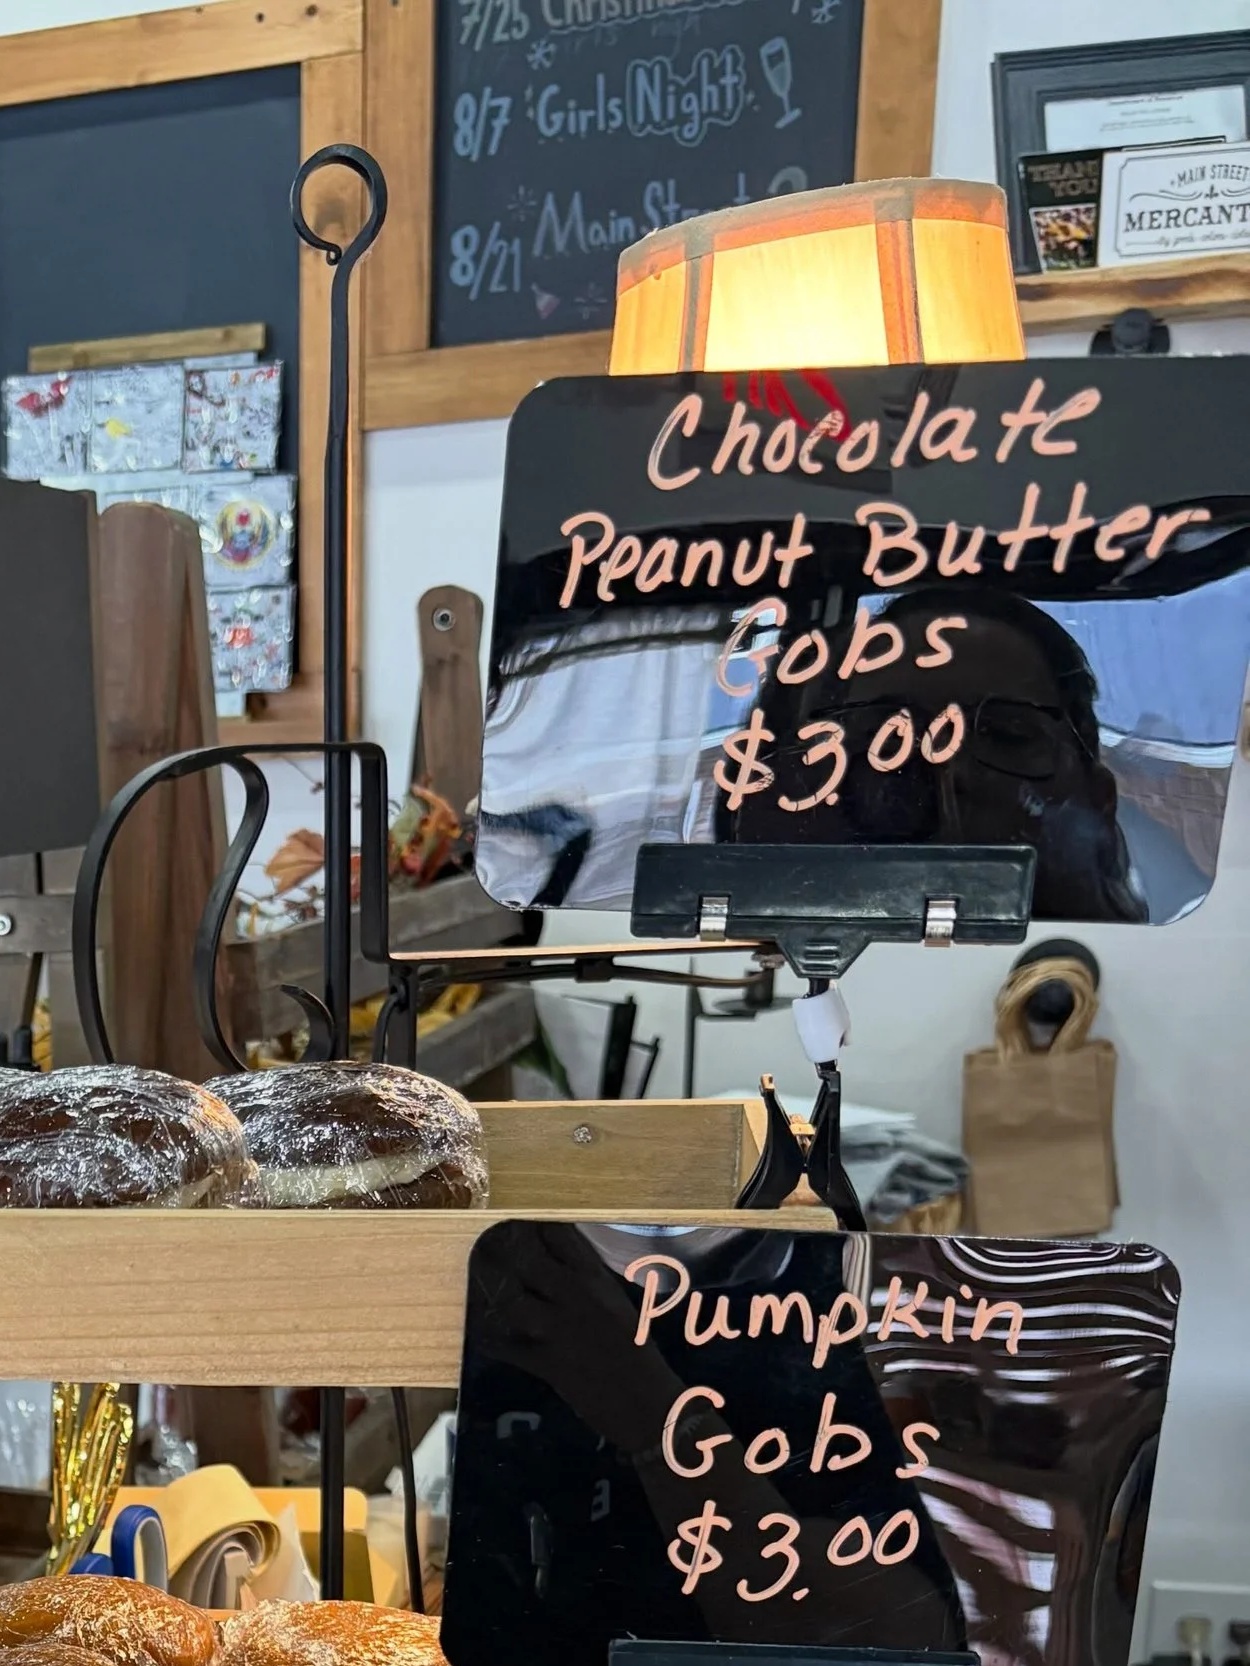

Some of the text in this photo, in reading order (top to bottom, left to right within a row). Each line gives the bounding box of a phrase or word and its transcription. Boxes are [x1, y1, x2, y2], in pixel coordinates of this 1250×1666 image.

[453, 49, 741, 161] 8/7 Girls Night
[1050, 178, 1098, 198] YOU
[1177, 168, 1206, 187] MAIN
[450, 221, 520, 300] 8/21
[532, 191, 635, 258] Main
[646, 376, 1102, 491] Chocolate
[558, 481, 1211, 608] Peanut Butter
[713, 597, 968, 697] Gobs
[623, 1253, 1026, 1369] Pumpkin
[661, 1385, 942, 1480] Gobs
